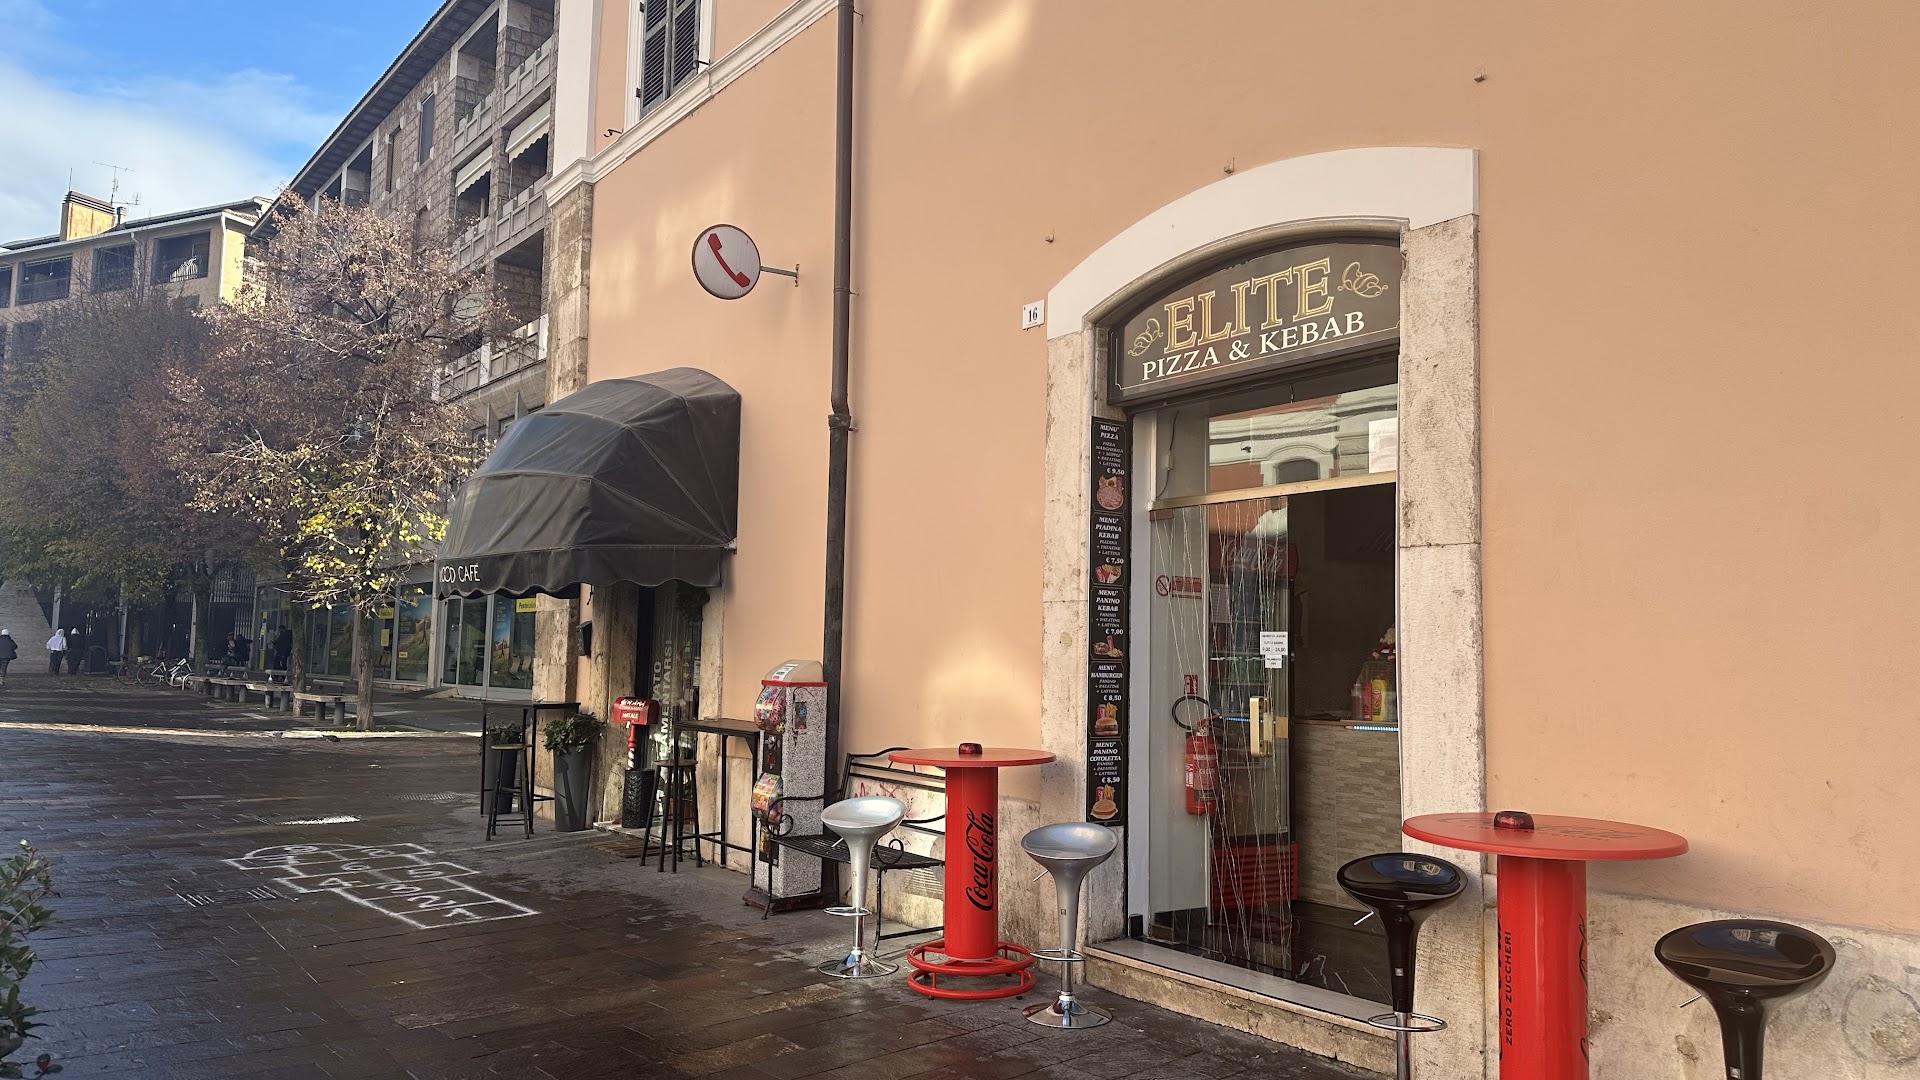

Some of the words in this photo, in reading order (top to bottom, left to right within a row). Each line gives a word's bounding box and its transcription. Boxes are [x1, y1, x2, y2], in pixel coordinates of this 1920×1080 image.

[1028, 306, 1038, 323] 16
[1142, 345, 1220, 381] PIZZA
[1228, 339, 1250, 361] &
[1259, 310, 1365, 354] KEBAB
[1163, 256, 1335, 354] ELITE
[966, 807, 994, 911] Coca-Cola
